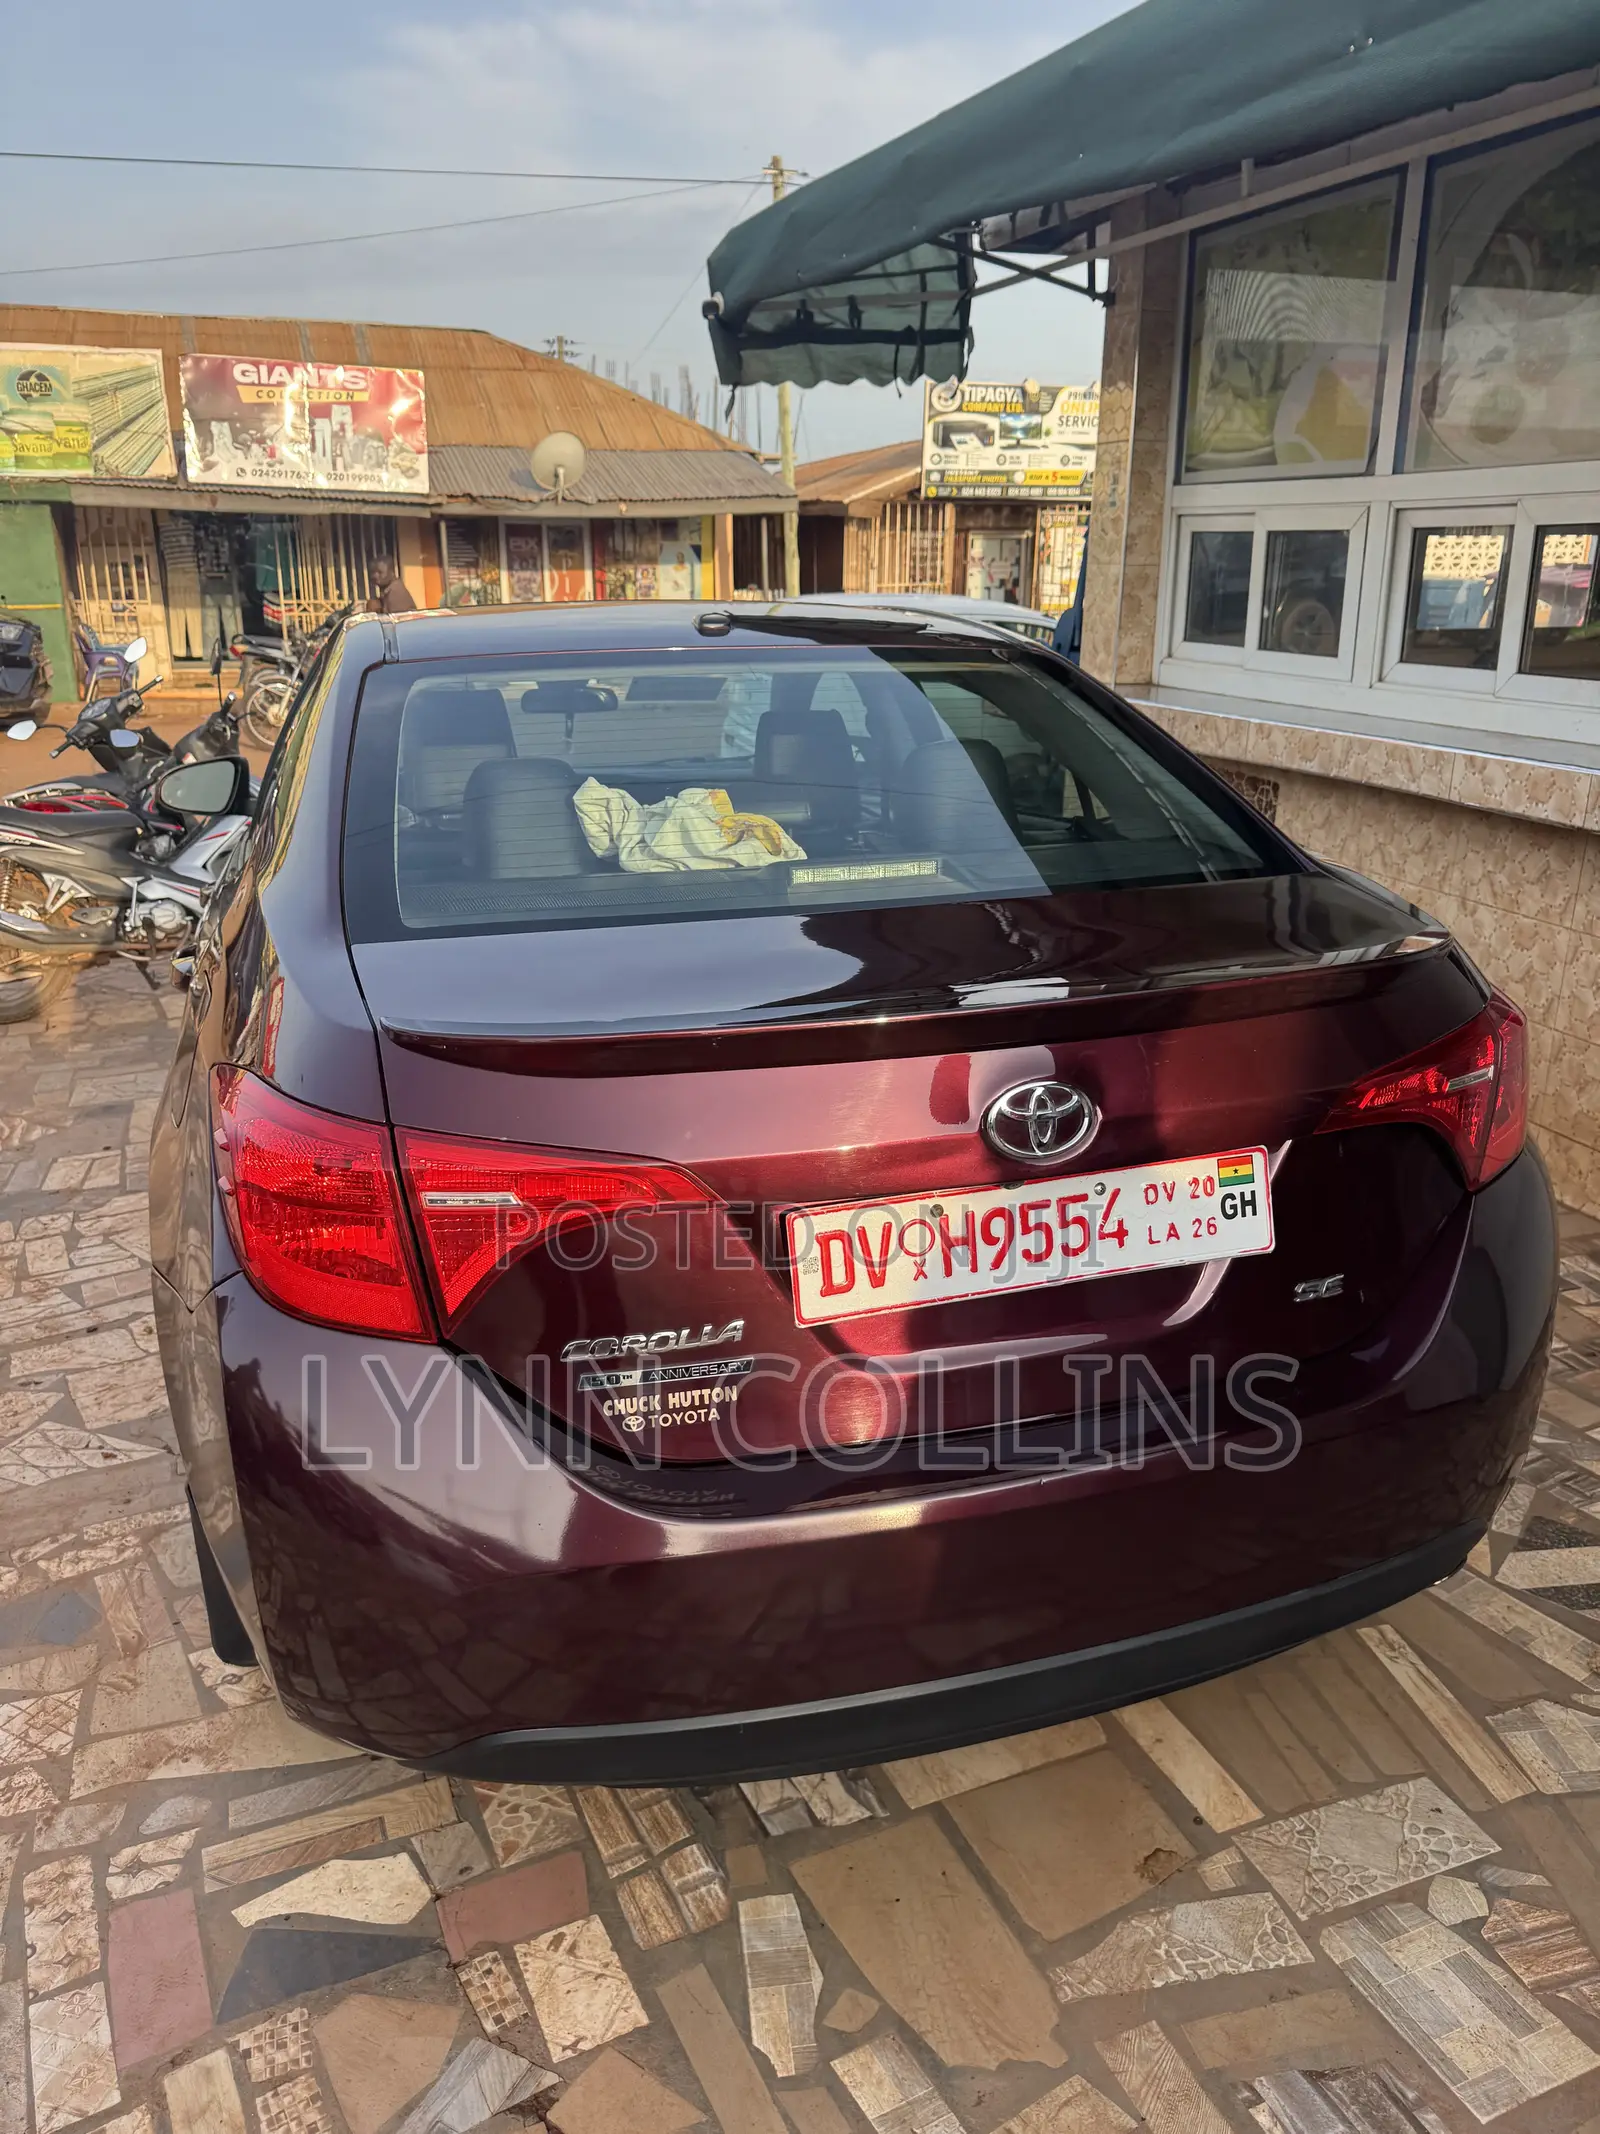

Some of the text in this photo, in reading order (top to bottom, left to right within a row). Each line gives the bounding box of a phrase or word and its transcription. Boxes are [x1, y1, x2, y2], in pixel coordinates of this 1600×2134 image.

[16, 381, 53, 393] GHACEM
[232, 362, 368, 390] GIANTS
[1143, 1174, 1215, 1206] DV 20
[1219, 1189, 1258, 1221] GH
[1147, 1215, 1218, 1245] LA 26
[815, 1221, 893, 1298] DV
[560, 1317, 745, 1362] COROLLA
[649, 1359, 748, 1381] ANNIVERSARY
[602, 1384, 738, 1417] CHUCK HUTTON
[648, 1407, 721, 1428] TOYOTA
